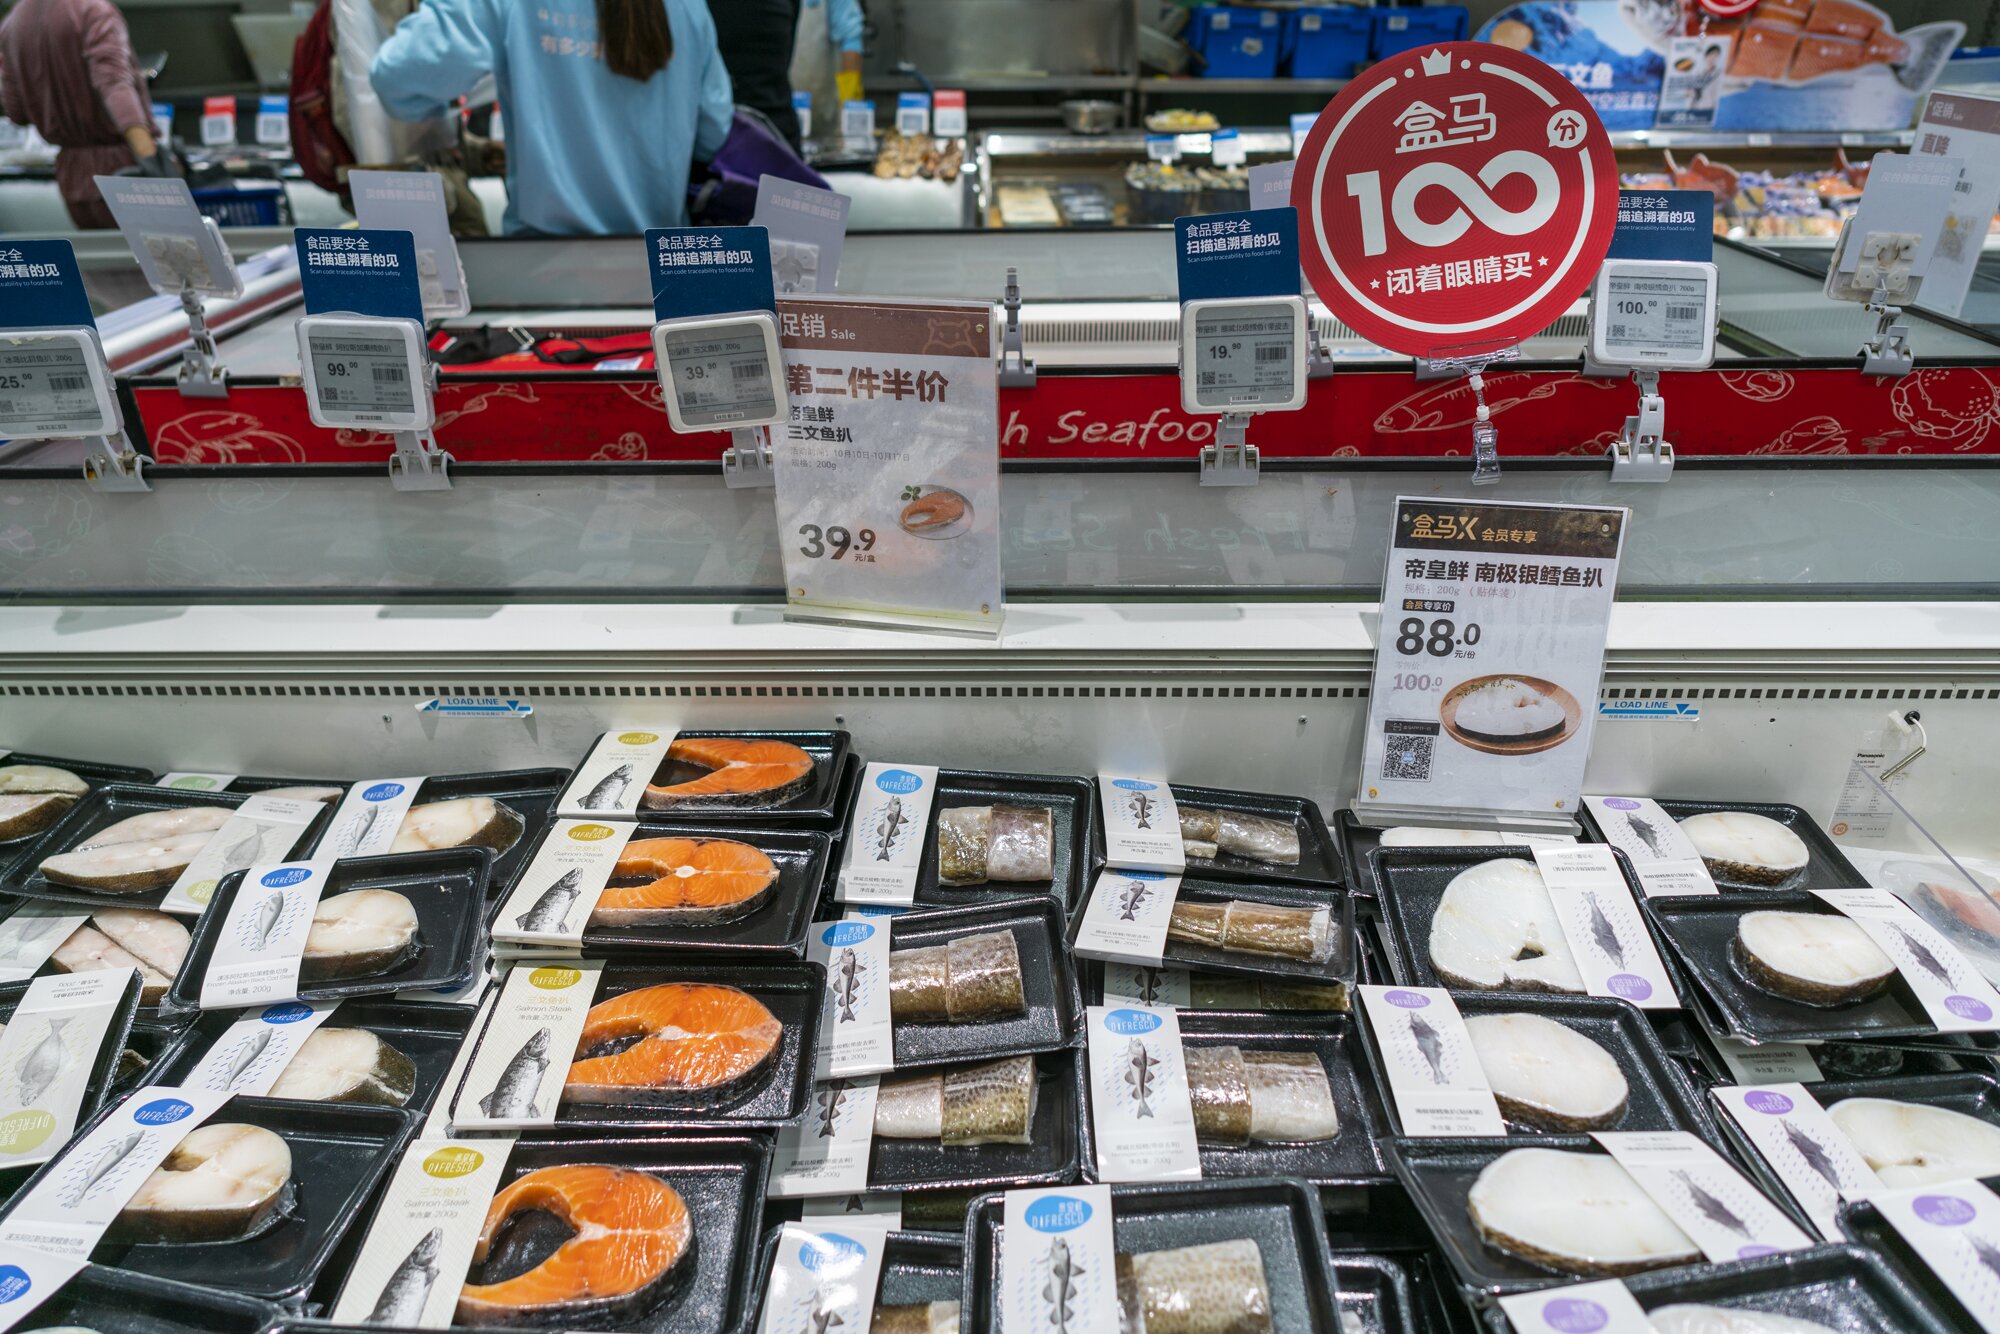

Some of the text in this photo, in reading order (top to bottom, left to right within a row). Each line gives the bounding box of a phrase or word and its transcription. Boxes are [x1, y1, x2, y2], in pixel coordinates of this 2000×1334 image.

[1393, 92, 1497, 154] 盒马
[1553, 116, 1580, 142] 分
[1186, 219, 1251, 239] 食品要安全
[306, 236, 370, 251] 食品要安全
[657, 234, 723, 250] 食品要安全
[1187, 232, 1280, 255] 扫描追溯看的见
[307, 252, 399, 267] 扫描追溯看的见
[659, 250, 753, 266] 扫描追溯看的见
[1214, 253, 1244, 261] traceability
[0, 263, 60, 278] 溯看的见
[336, 269, 365, 277] traceability
[1386, 251, 1532, 297] 闭着眼睛买
[777, 312, 856, 341] 促销 Sale
[787, 363, 949, 403] 第二件半价
[788, 425, 853, 443] 三文鱼扒
[1048, 408, 1217, 449] Seafoo
[799, 524, 876, 560] 39.9
[1481, 528, 1538, 544] 会员专享
[854, 554, 876, 563] 元/盒
[1405, 558, 1603, 588] 帝皇鲜 南极银鳕鱼扒
[1405, 600, 1452, 612] 会员专享价
[1396, 617, 1481, 657] 88.0
[1455, 650, 1476, 659] 元/份
[1392, 673, 1443, 692] 100.0
[880, 781, 916, 791] DIFRESCO
[265, 875, 304, 886] DIFRESCO
[828, 931, 868, 944] DIFRESCO
[533, 977, 574, 985] DIFRESCO
[1111, 1021, 1156, 1032] DIFRESCO
[136, 1110, 183, 1122] DIFRESCO
[427, 1162, 474, 1173] DIFRESCO
[1032, 1211, 1084, 1228] DIFRESCO
